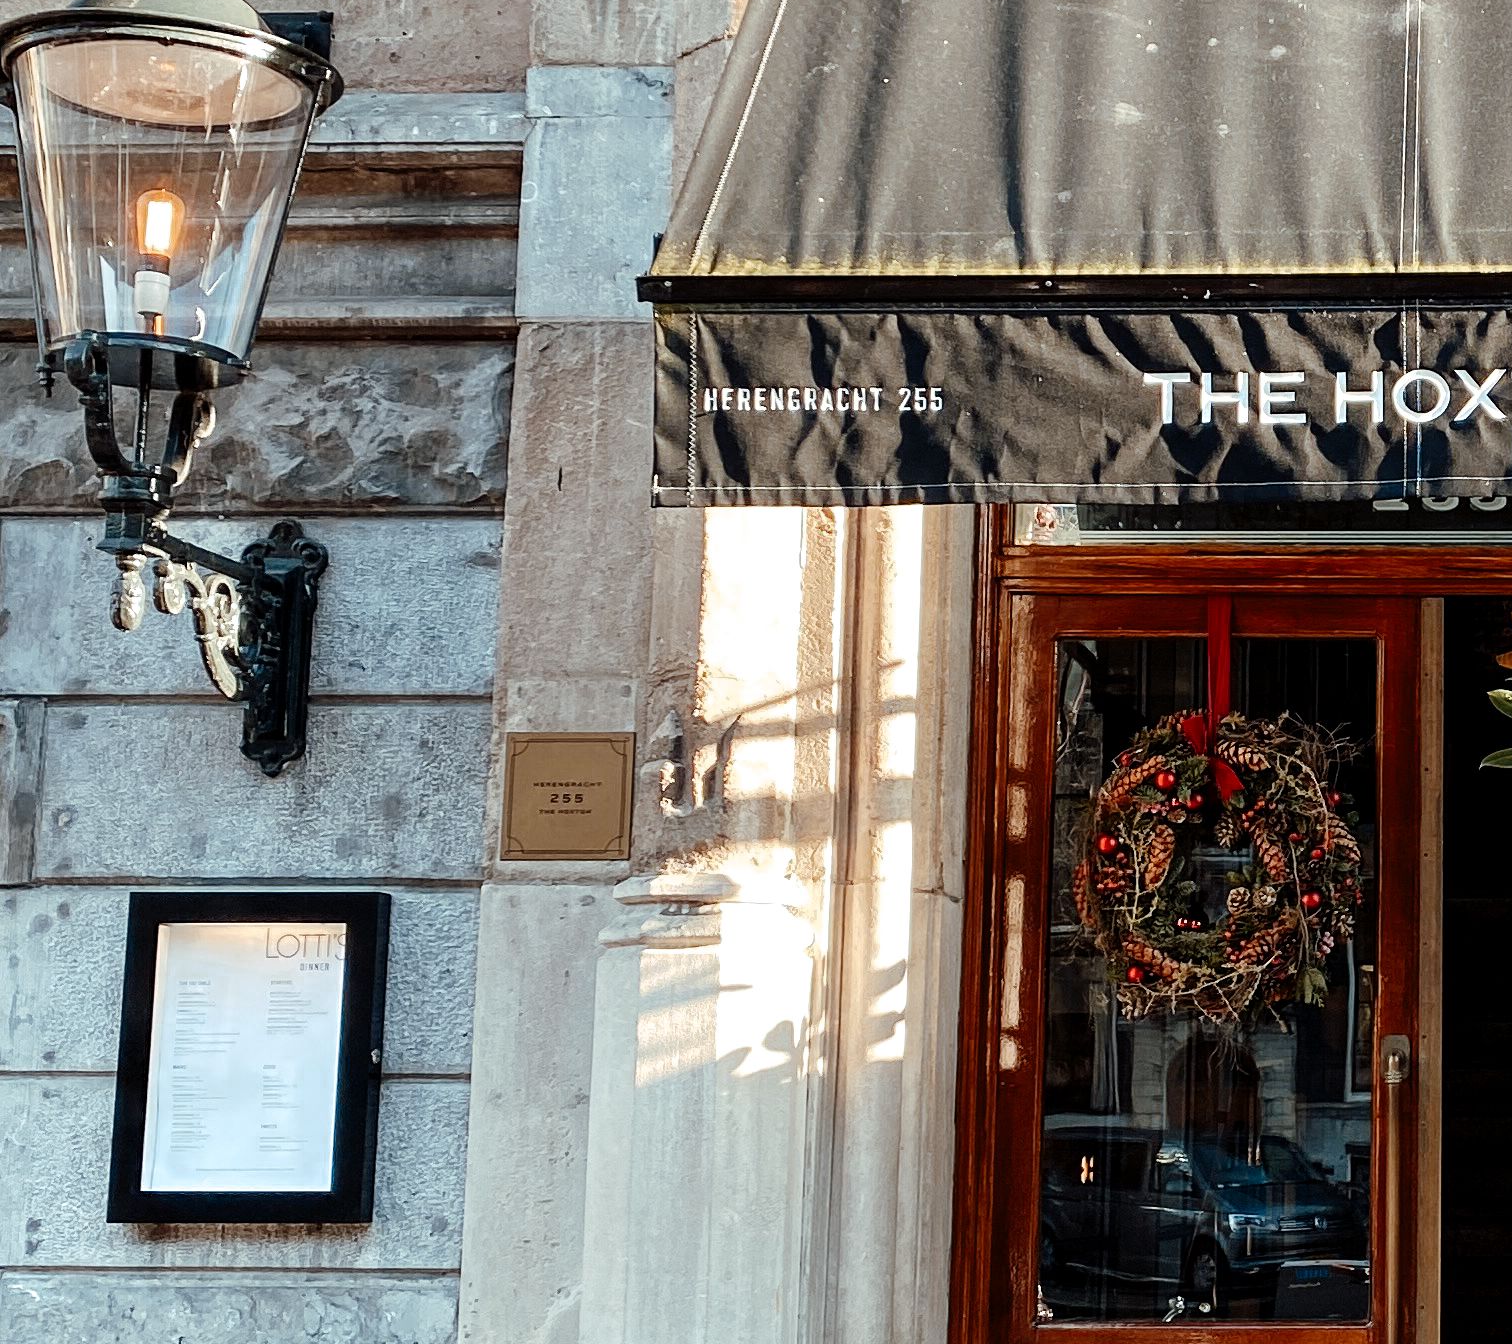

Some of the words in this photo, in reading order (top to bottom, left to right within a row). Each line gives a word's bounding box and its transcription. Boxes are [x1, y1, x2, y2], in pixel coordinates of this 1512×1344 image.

[703, 387, 883, 412] HERENGRACHT
[898, 387, 943, 411] 255
[1143, 371, 1307, 424] THE
[550, 793, 584, 804] 255
[299, 962, 330, 971] DINNER
